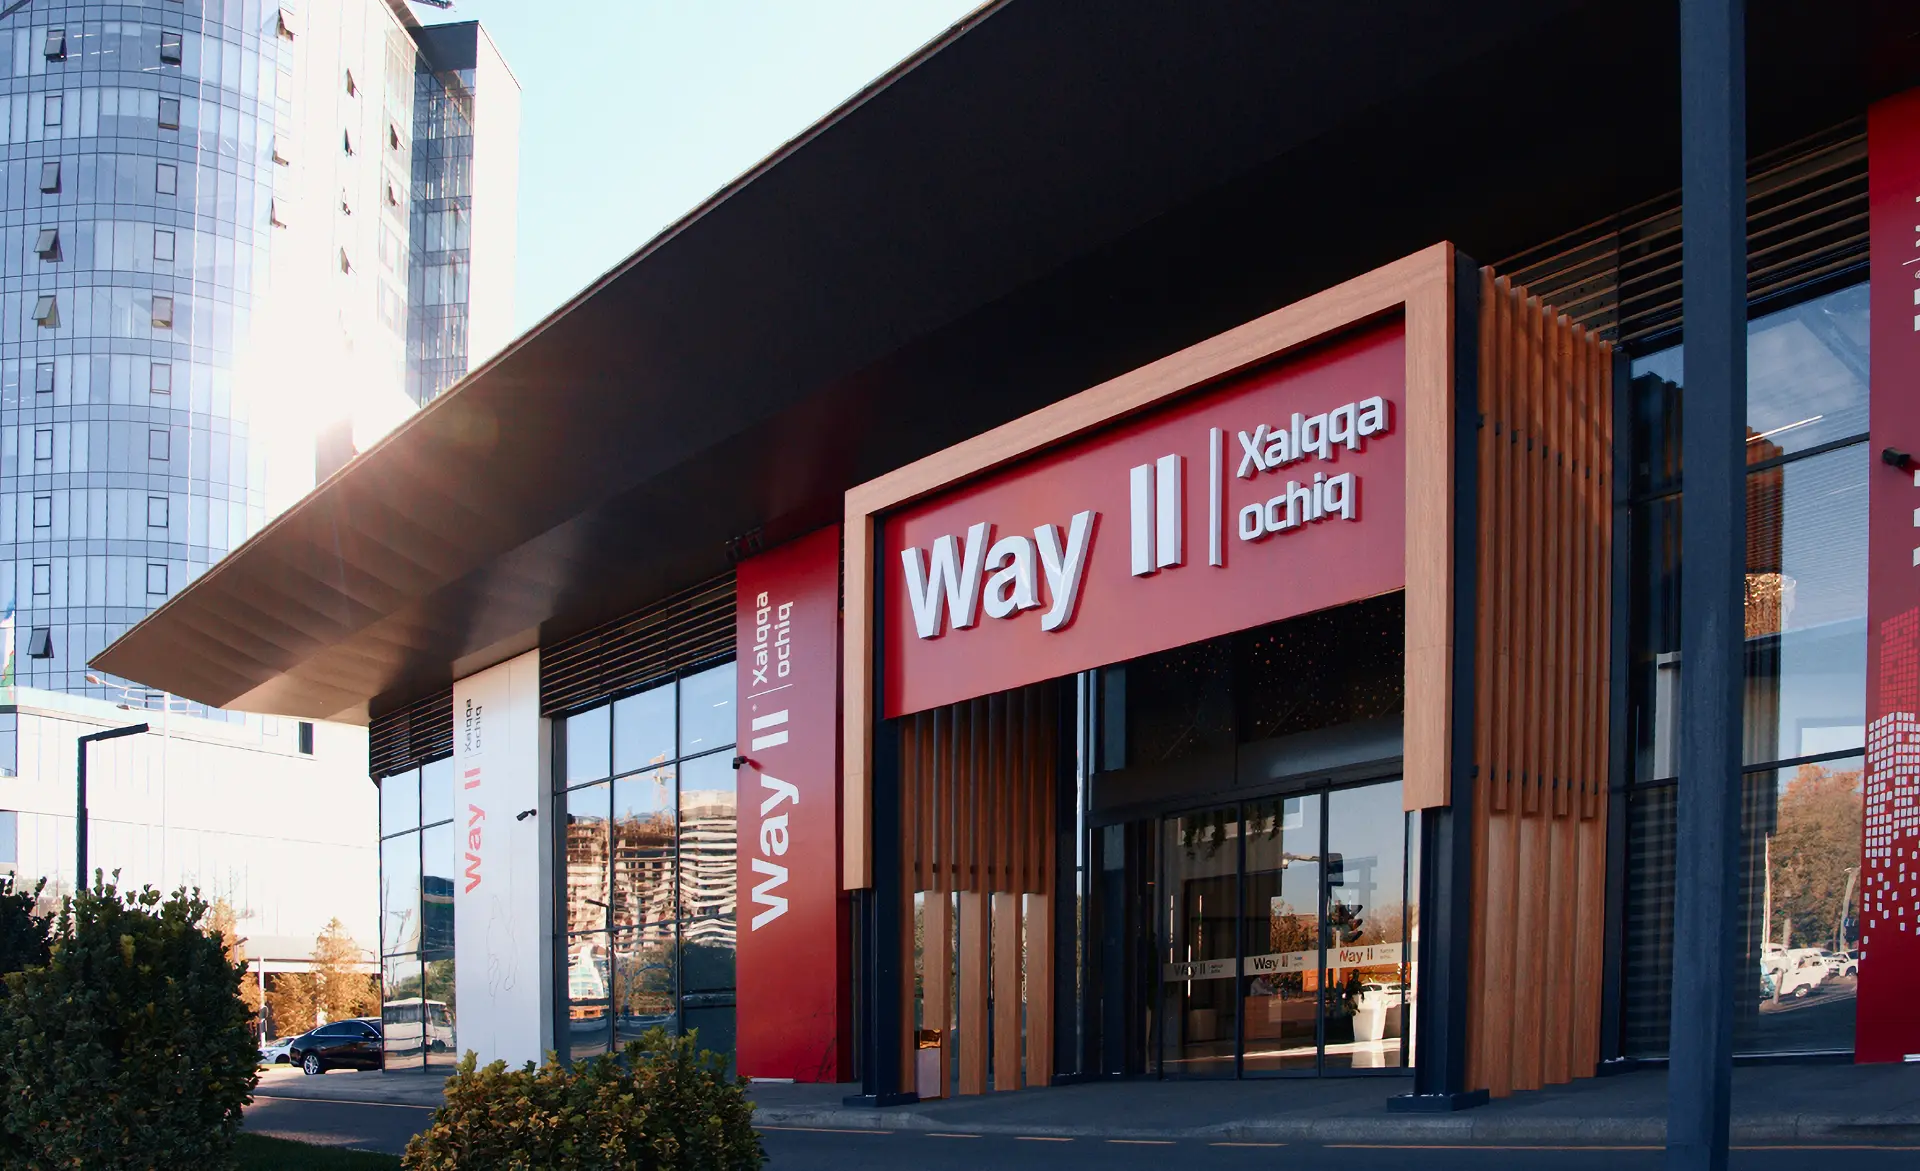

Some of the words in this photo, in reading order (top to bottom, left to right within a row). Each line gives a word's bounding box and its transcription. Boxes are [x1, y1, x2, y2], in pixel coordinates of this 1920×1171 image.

[1236, 395, 1394, 480] Xalqqa
[1237, 471, 1357, 543] ochiq
[900, 508, 1101, 640] Way
[752, 591, 772, 687] Xalqqa
[774, 601, 794, 678] ochiq
[464, 803, 486, 894] Way
[751, 773, 800, 932] Way
[1253, 957, 1279, 971] Way
